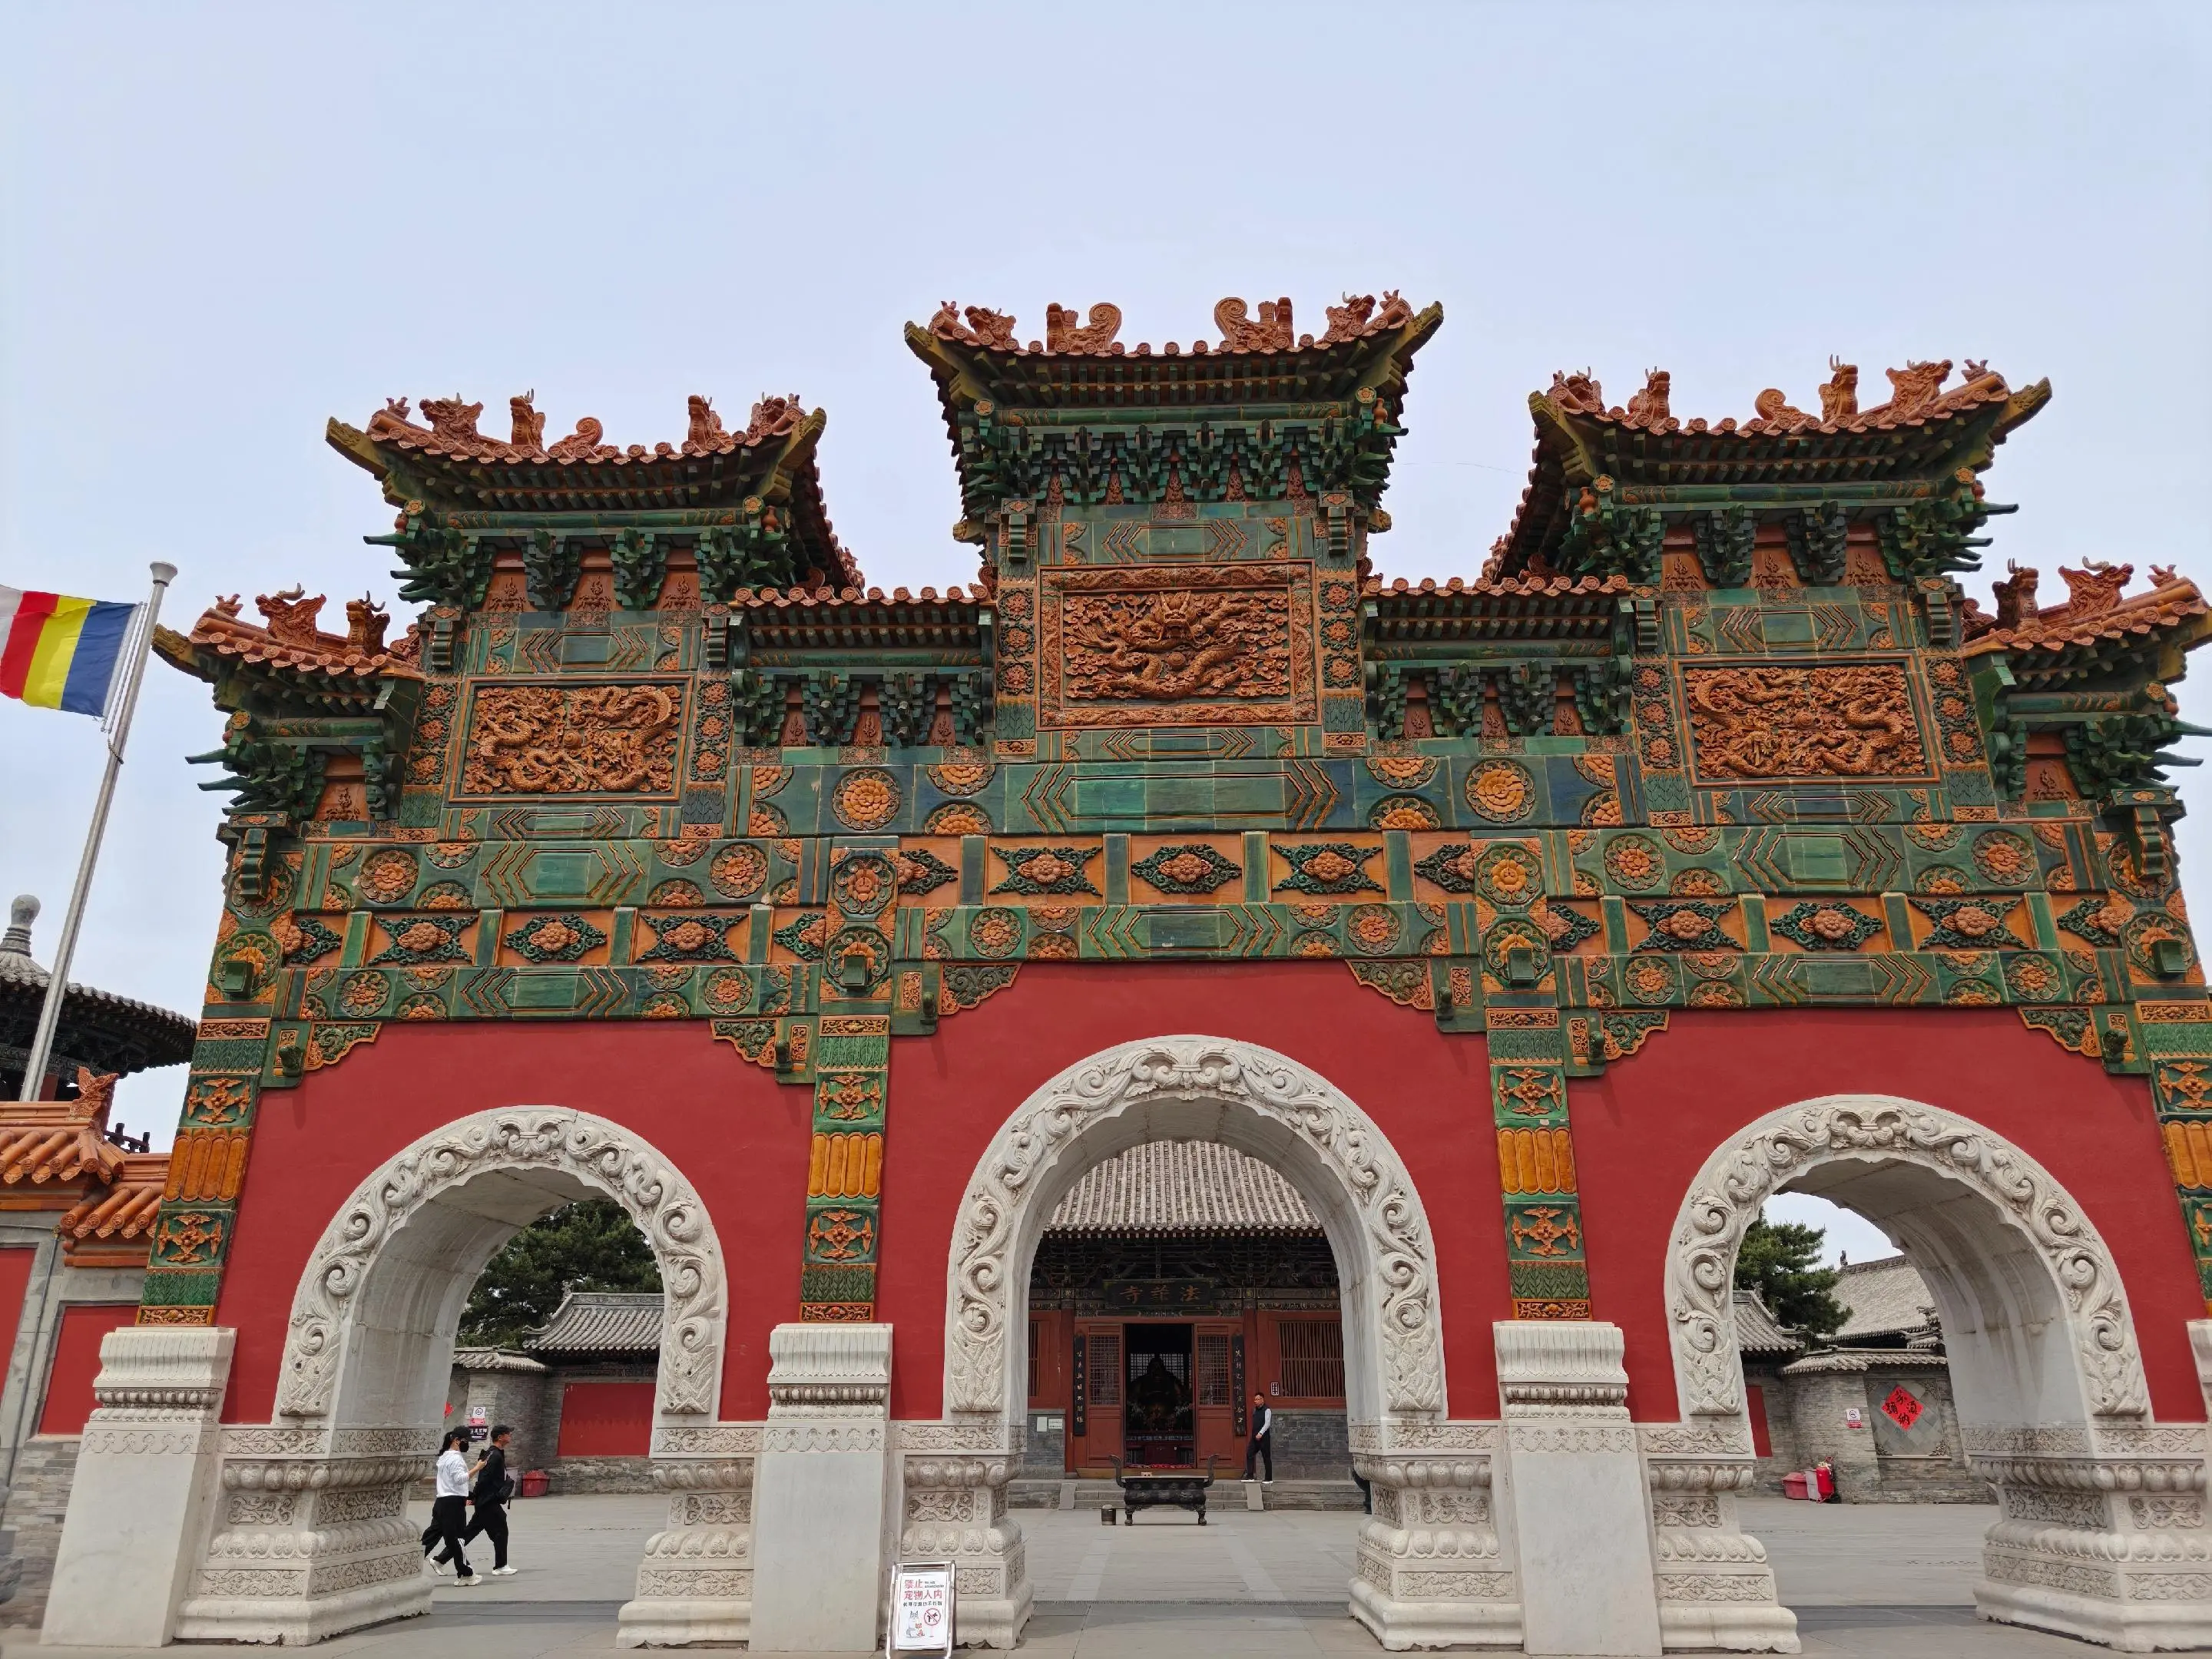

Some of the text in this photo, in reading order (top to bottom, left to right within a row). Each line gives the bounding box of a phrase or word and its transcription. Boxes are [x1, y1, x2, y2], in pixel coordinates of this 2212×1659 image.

[905, 1579, 923, 1589] 禁止
[904, 1589, 942, 1600] 宠物入内
